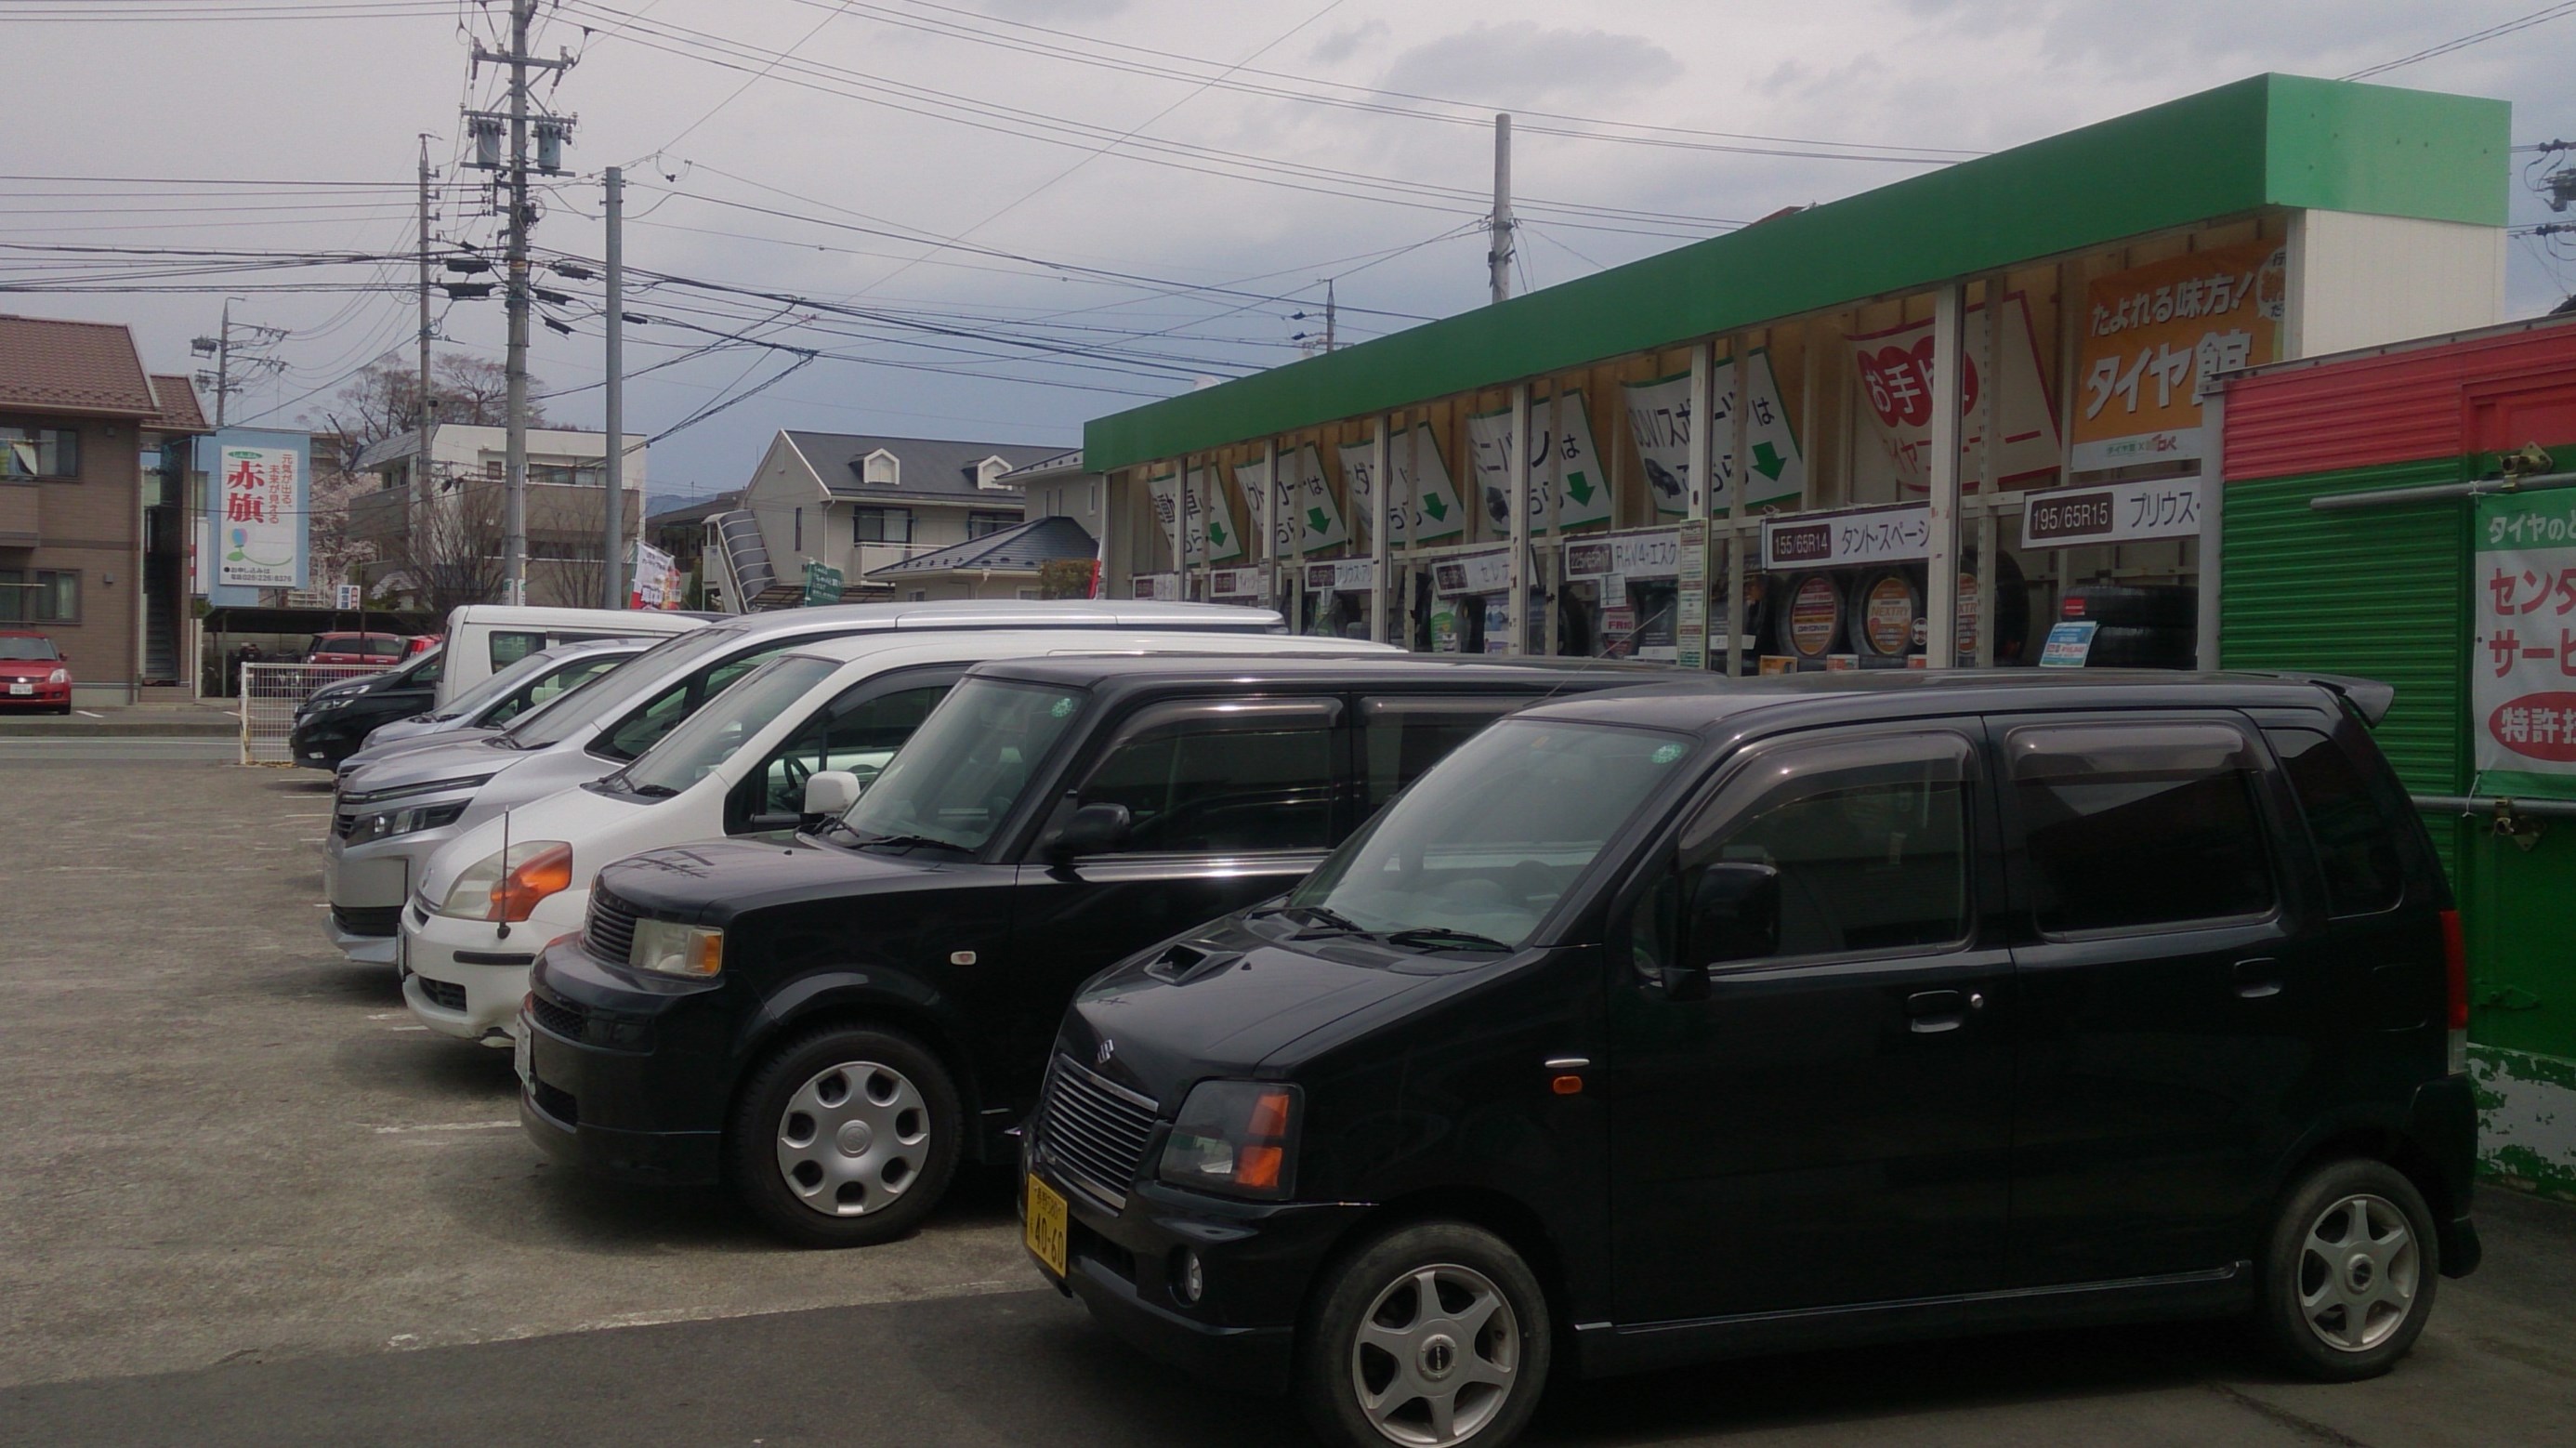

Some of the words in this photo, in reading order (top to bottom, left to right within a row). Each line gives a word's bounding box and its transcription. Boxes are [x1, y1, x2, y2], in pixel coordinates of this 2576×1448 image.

[227, 460, 265, 523] 赤旗
[2032, 503, 2109, 531] 195/65R15
[1774, 533, 1829, 557] 155/65R14
[1872, 605, 1910, 617] NEXTRY
